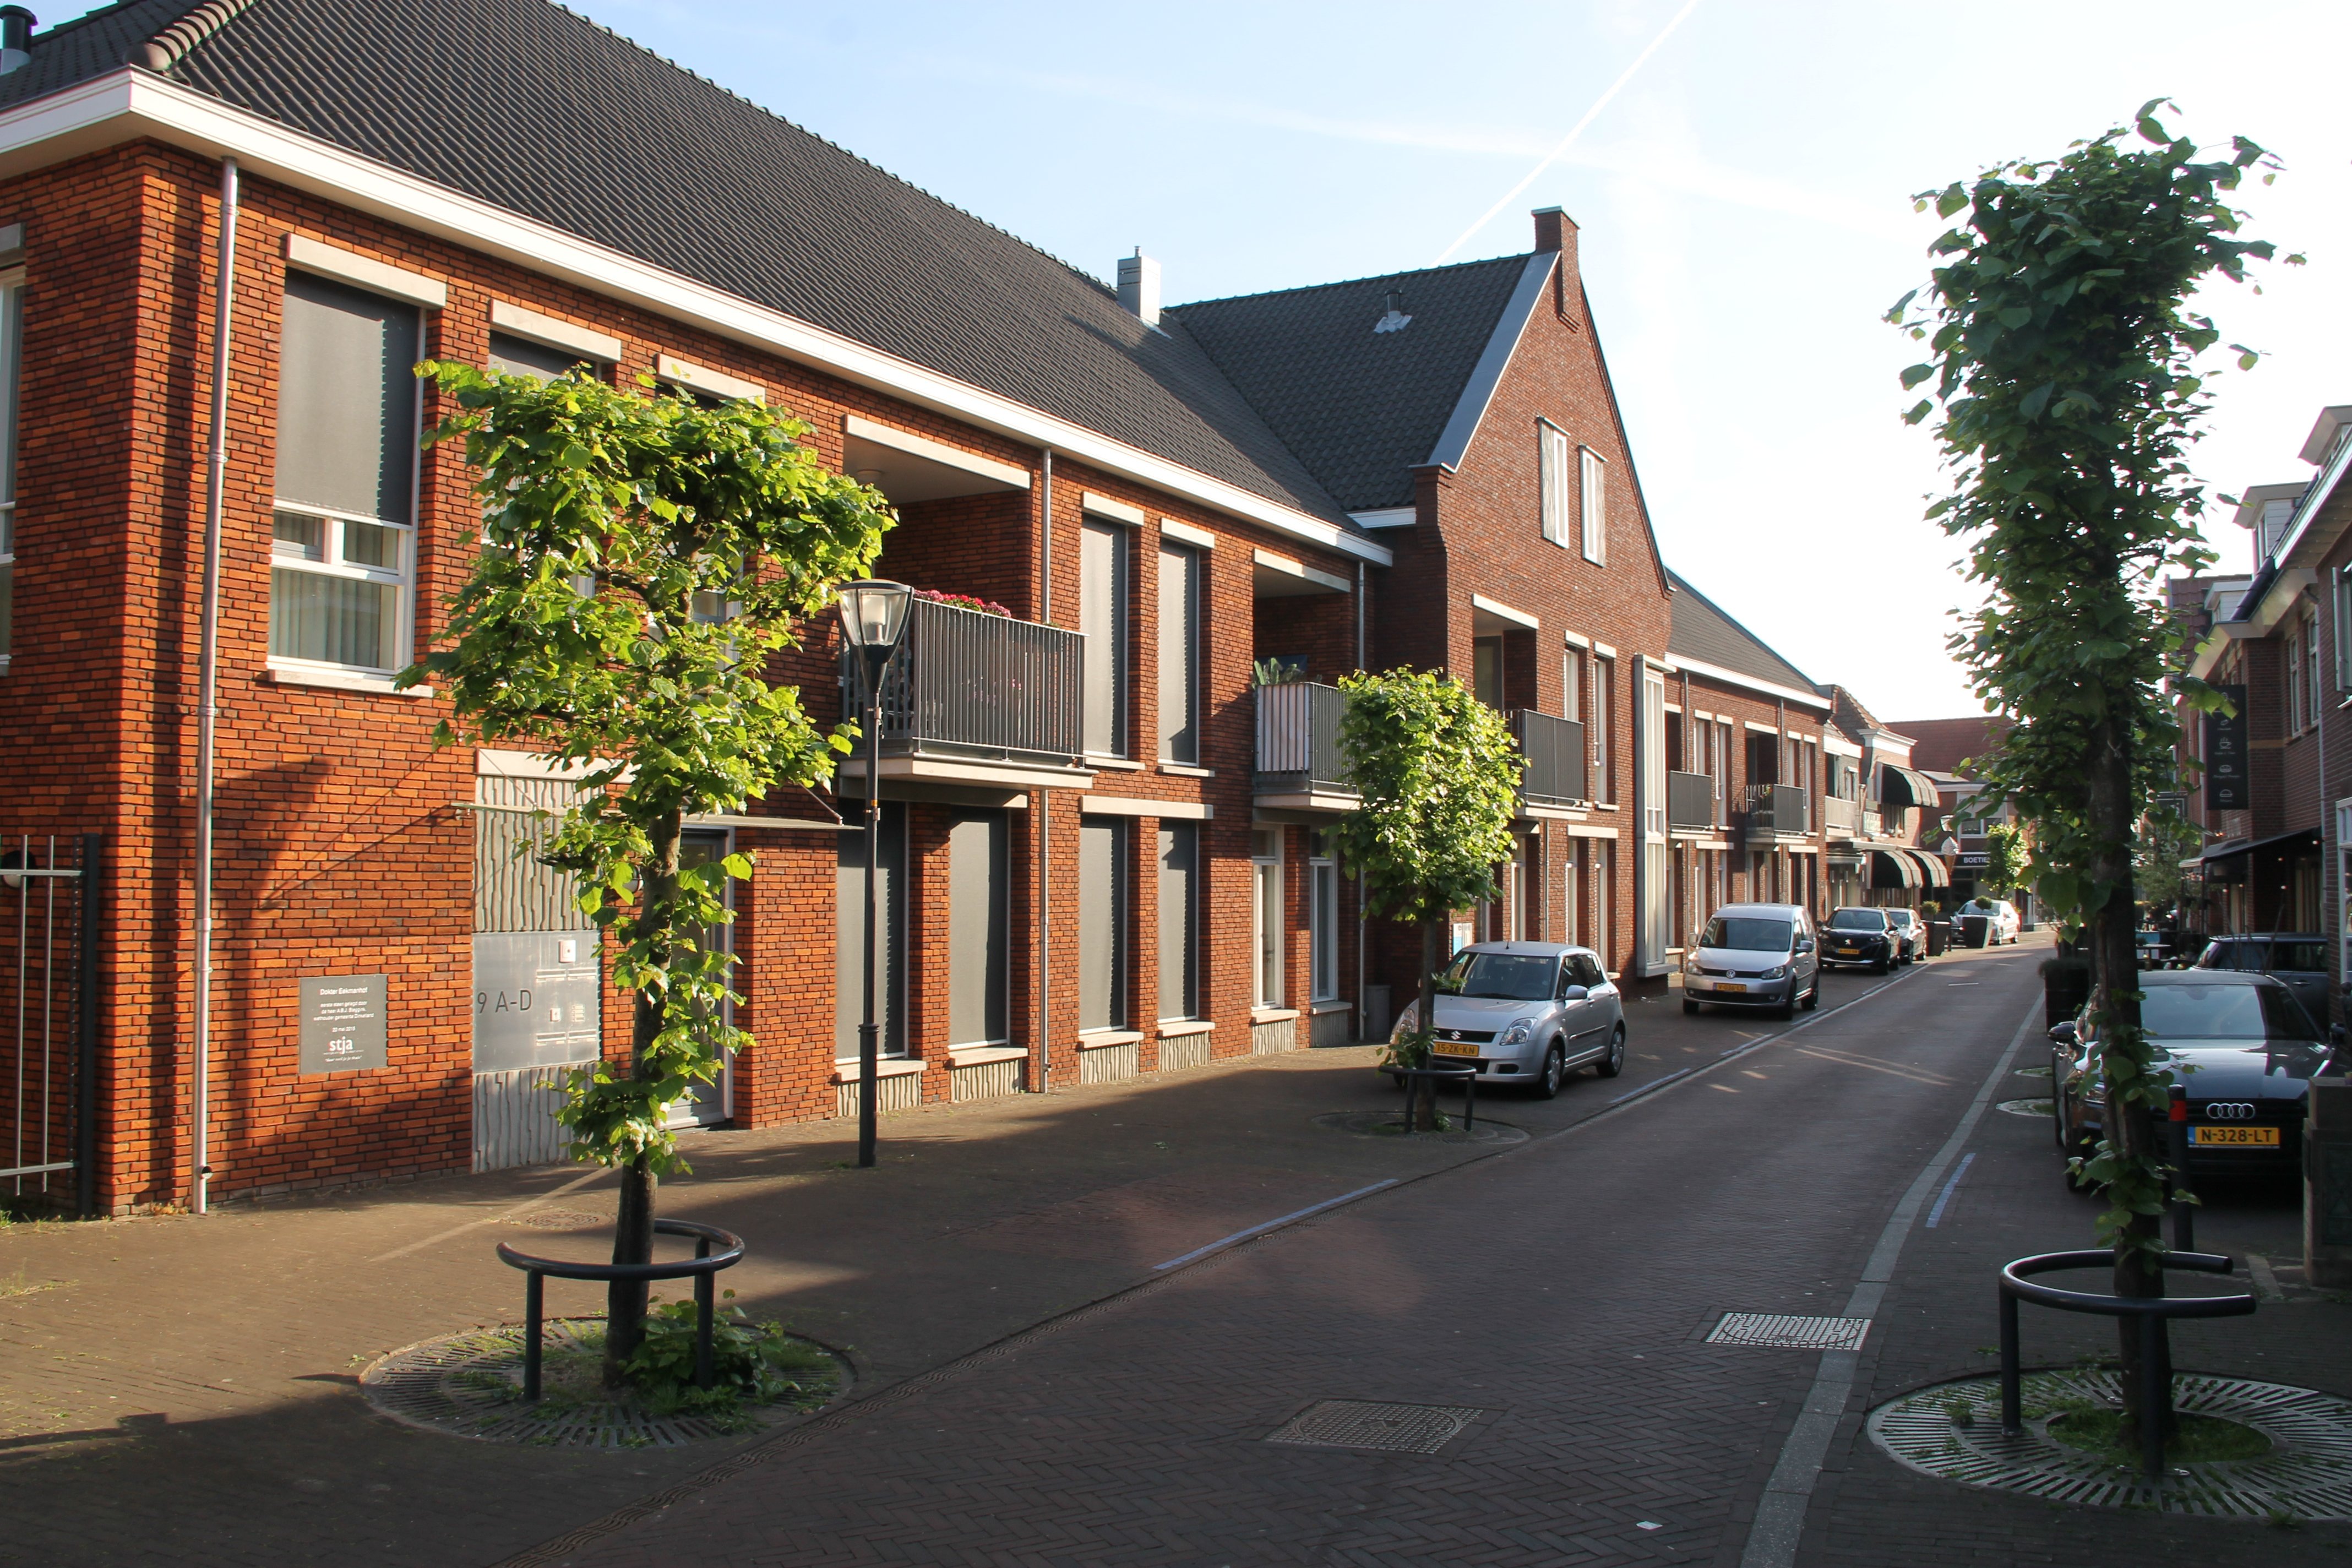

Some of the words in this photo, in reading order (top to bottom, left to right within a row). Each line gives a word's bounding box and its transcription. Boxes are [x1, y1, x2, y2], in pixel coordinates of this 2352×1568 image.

[477, 992, 487, 1013] 9
[495, 989, 532, 1012] A-D
[329, 1036, 353, 1054] stja
[1437, 1043, 1475, 1054] 15-ZK-KN
[2201, 1129, 2272, 1142] N-328-LT
